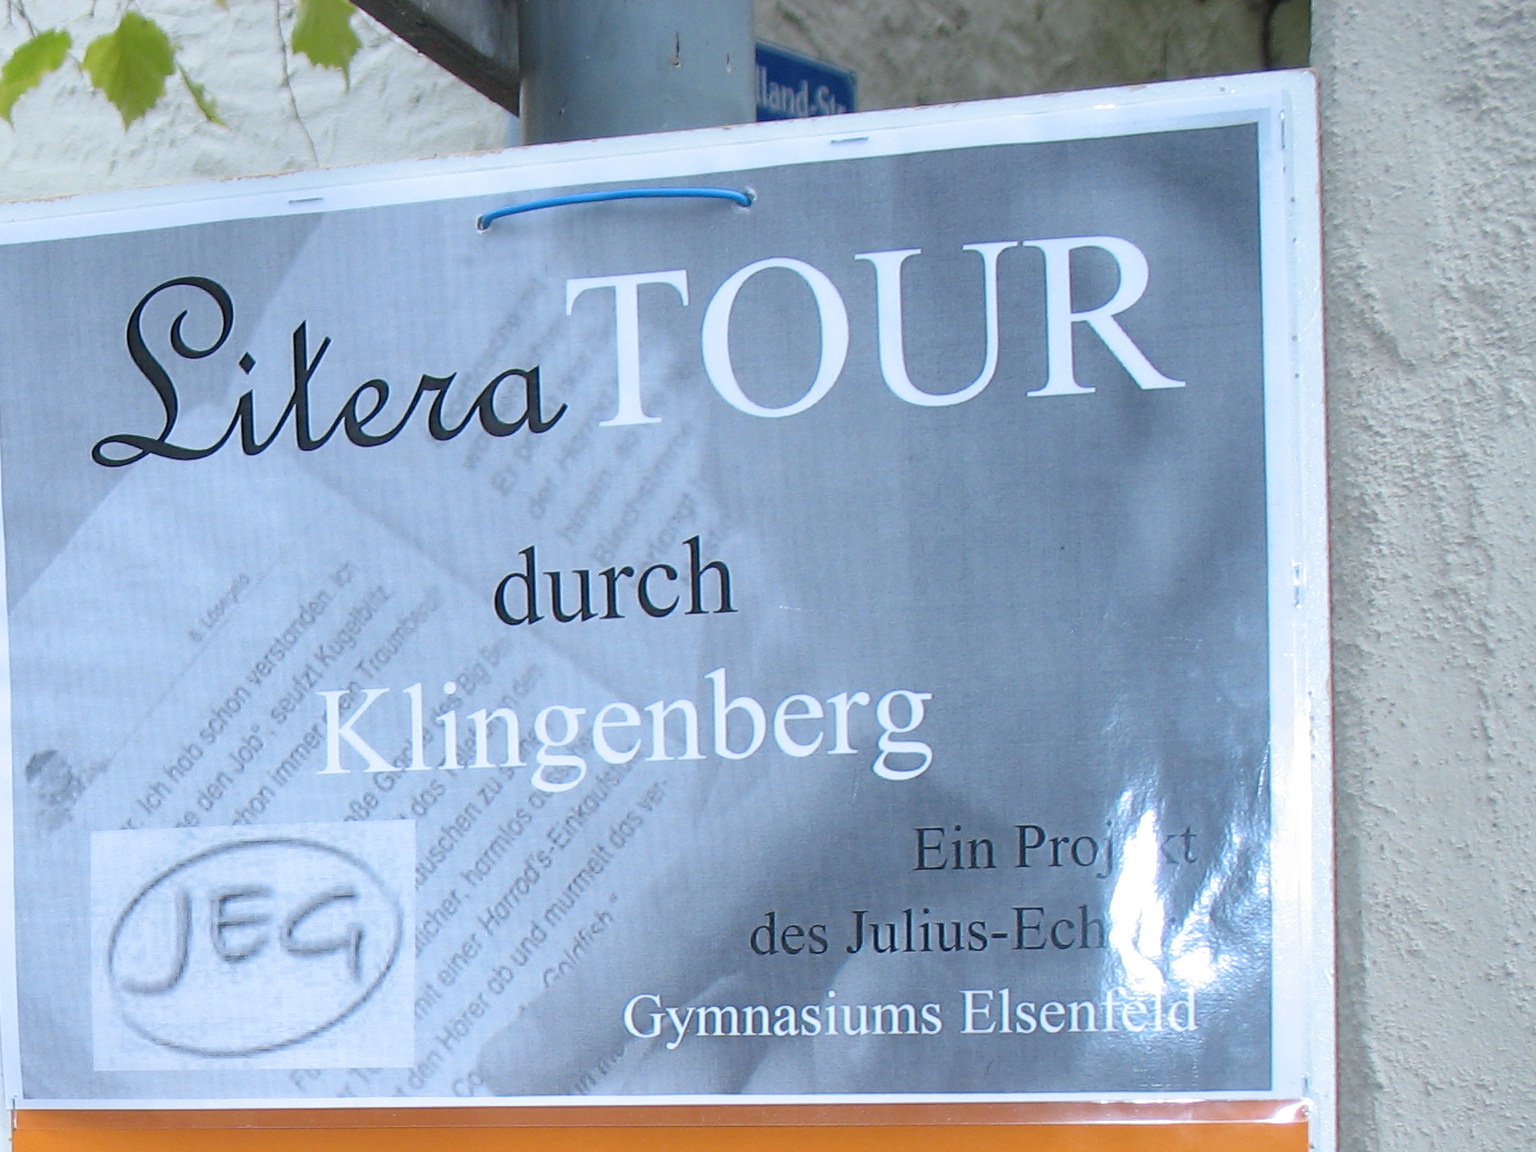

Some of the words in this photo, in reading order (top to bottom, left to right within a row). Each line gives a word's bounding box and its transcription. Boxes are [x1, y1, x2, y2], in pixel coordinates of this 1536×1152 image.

[495, 536, 738, 625] durch
[160, 737, 205, 784] hab
[192, 681, 253, 745] schon
[268, 723, 328, 787] immer
[316, 668, 931, 792] Klingenberg
[192, 767, 234, 812] den
[457, 806, 537, 887] harmlos
[914, 825, 996, 870] Ein
[1016, 820, 1197, 879] Projkt
[483, 962, 517, 996] ab
[503, 921, 550, 967] und
[535, 845, 621, 927] murmelt
[605, 809, 645, 849] das
[751, 912, 827, 955] des
[433, 932, 487, 988] einer
[625, 991, 941, 1049] Gymnasiums
[965, 986, 1202, 1037] Elsenfeld
